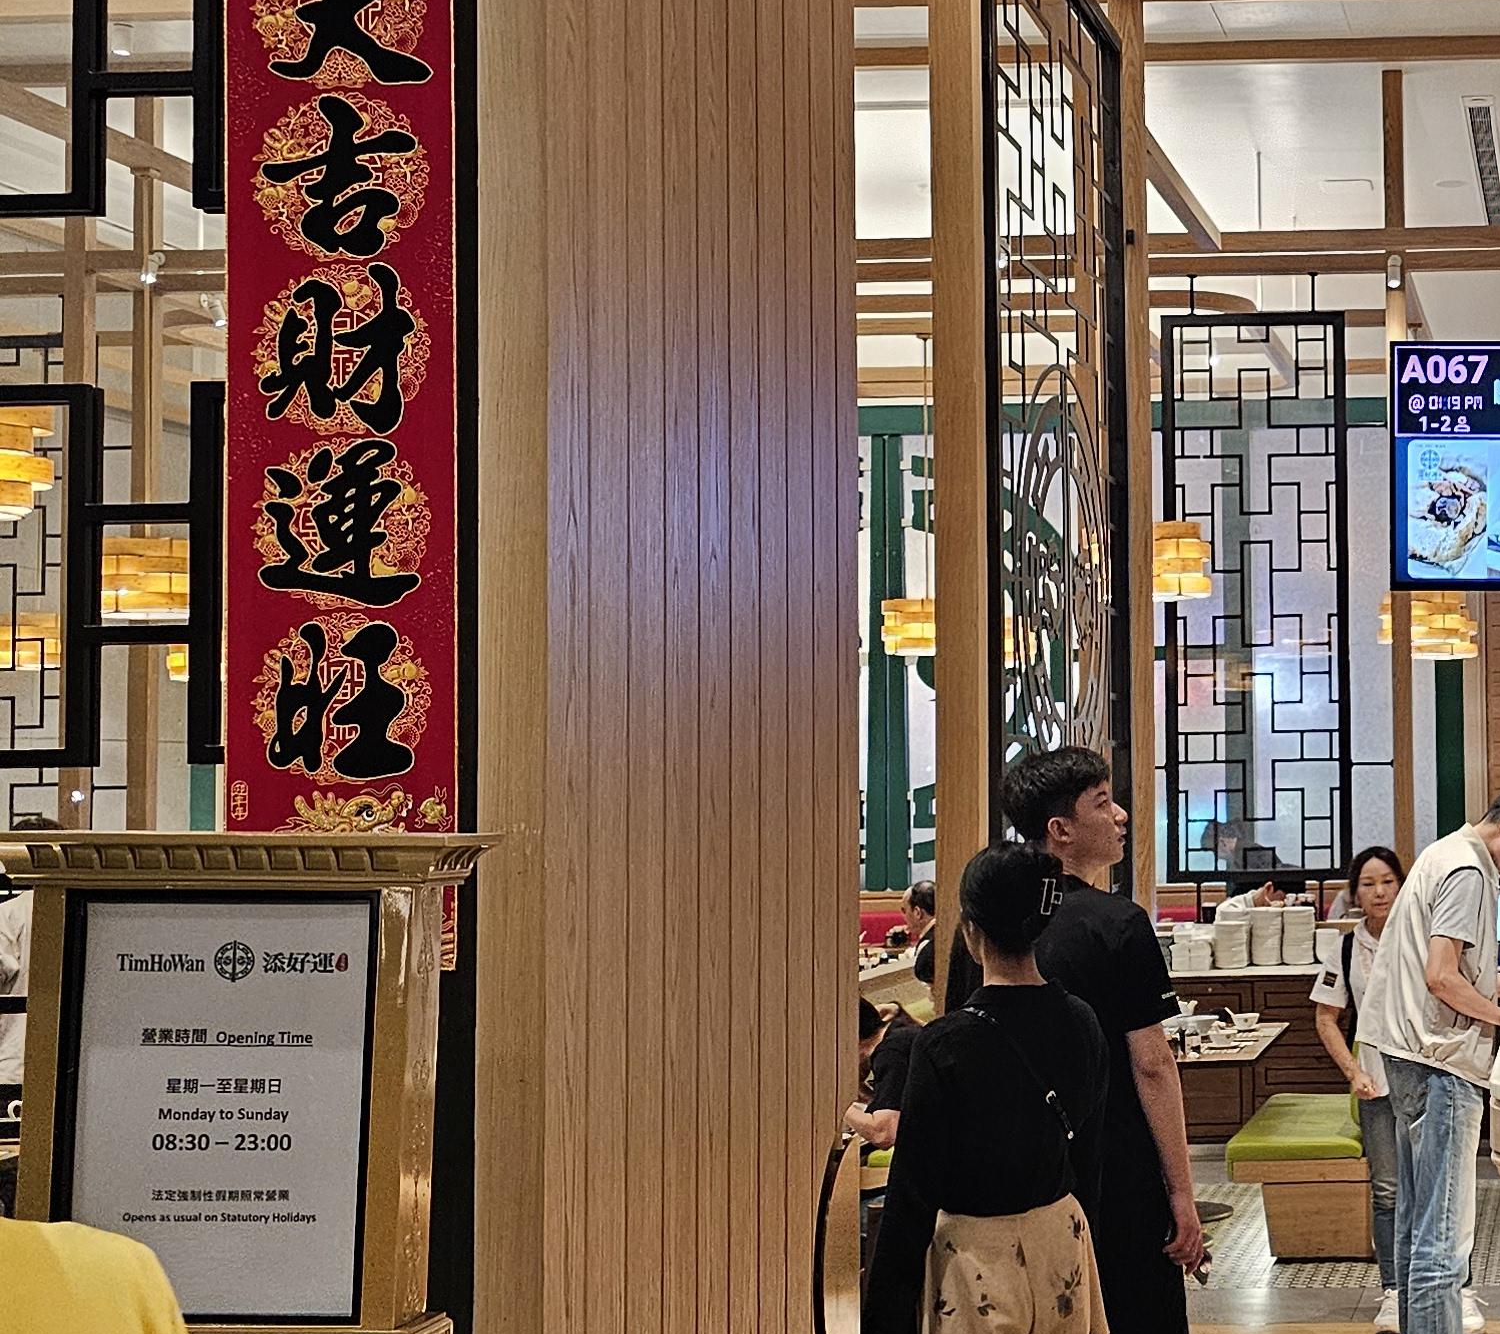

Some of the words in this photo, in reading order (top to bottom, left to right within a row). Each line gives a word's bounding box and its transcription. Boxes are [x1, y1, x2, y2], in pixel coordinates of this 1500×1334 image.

[1400, 355, 1489, 384] A067
[1464, 396, 1483, 410] PM
[1418, 416, 1452, 432] 1-2
[117, 953, 206, 973] TimHoWan
[262, 952, 335, 974] 添好運
[141, 1028, 208, 1044] 營業時間
[216, 1031, 275, 1046] Opening
[278, 1031, 313, 1044] Time
[165, 1078, 282, 1094] 星期一至星期日
[158, 1108, 216, 1123] Monday
[219, 1109, 234, 1121] to
[237, 1108, 289, 1123] Sunday
[152, 1133, 211, 1152] 08:30
[234, 1133, 292, 1152] 23:00
[122, 1212, 157, 1223] Opens
[159, 1214, 170, 1223] as
[173, 1212, 202, 1223] usual
[204, 1214, 218, 1223] on
[221, 1212, 270, 1224] Statutory
[272, 1212, 317, 1224] Holidays
